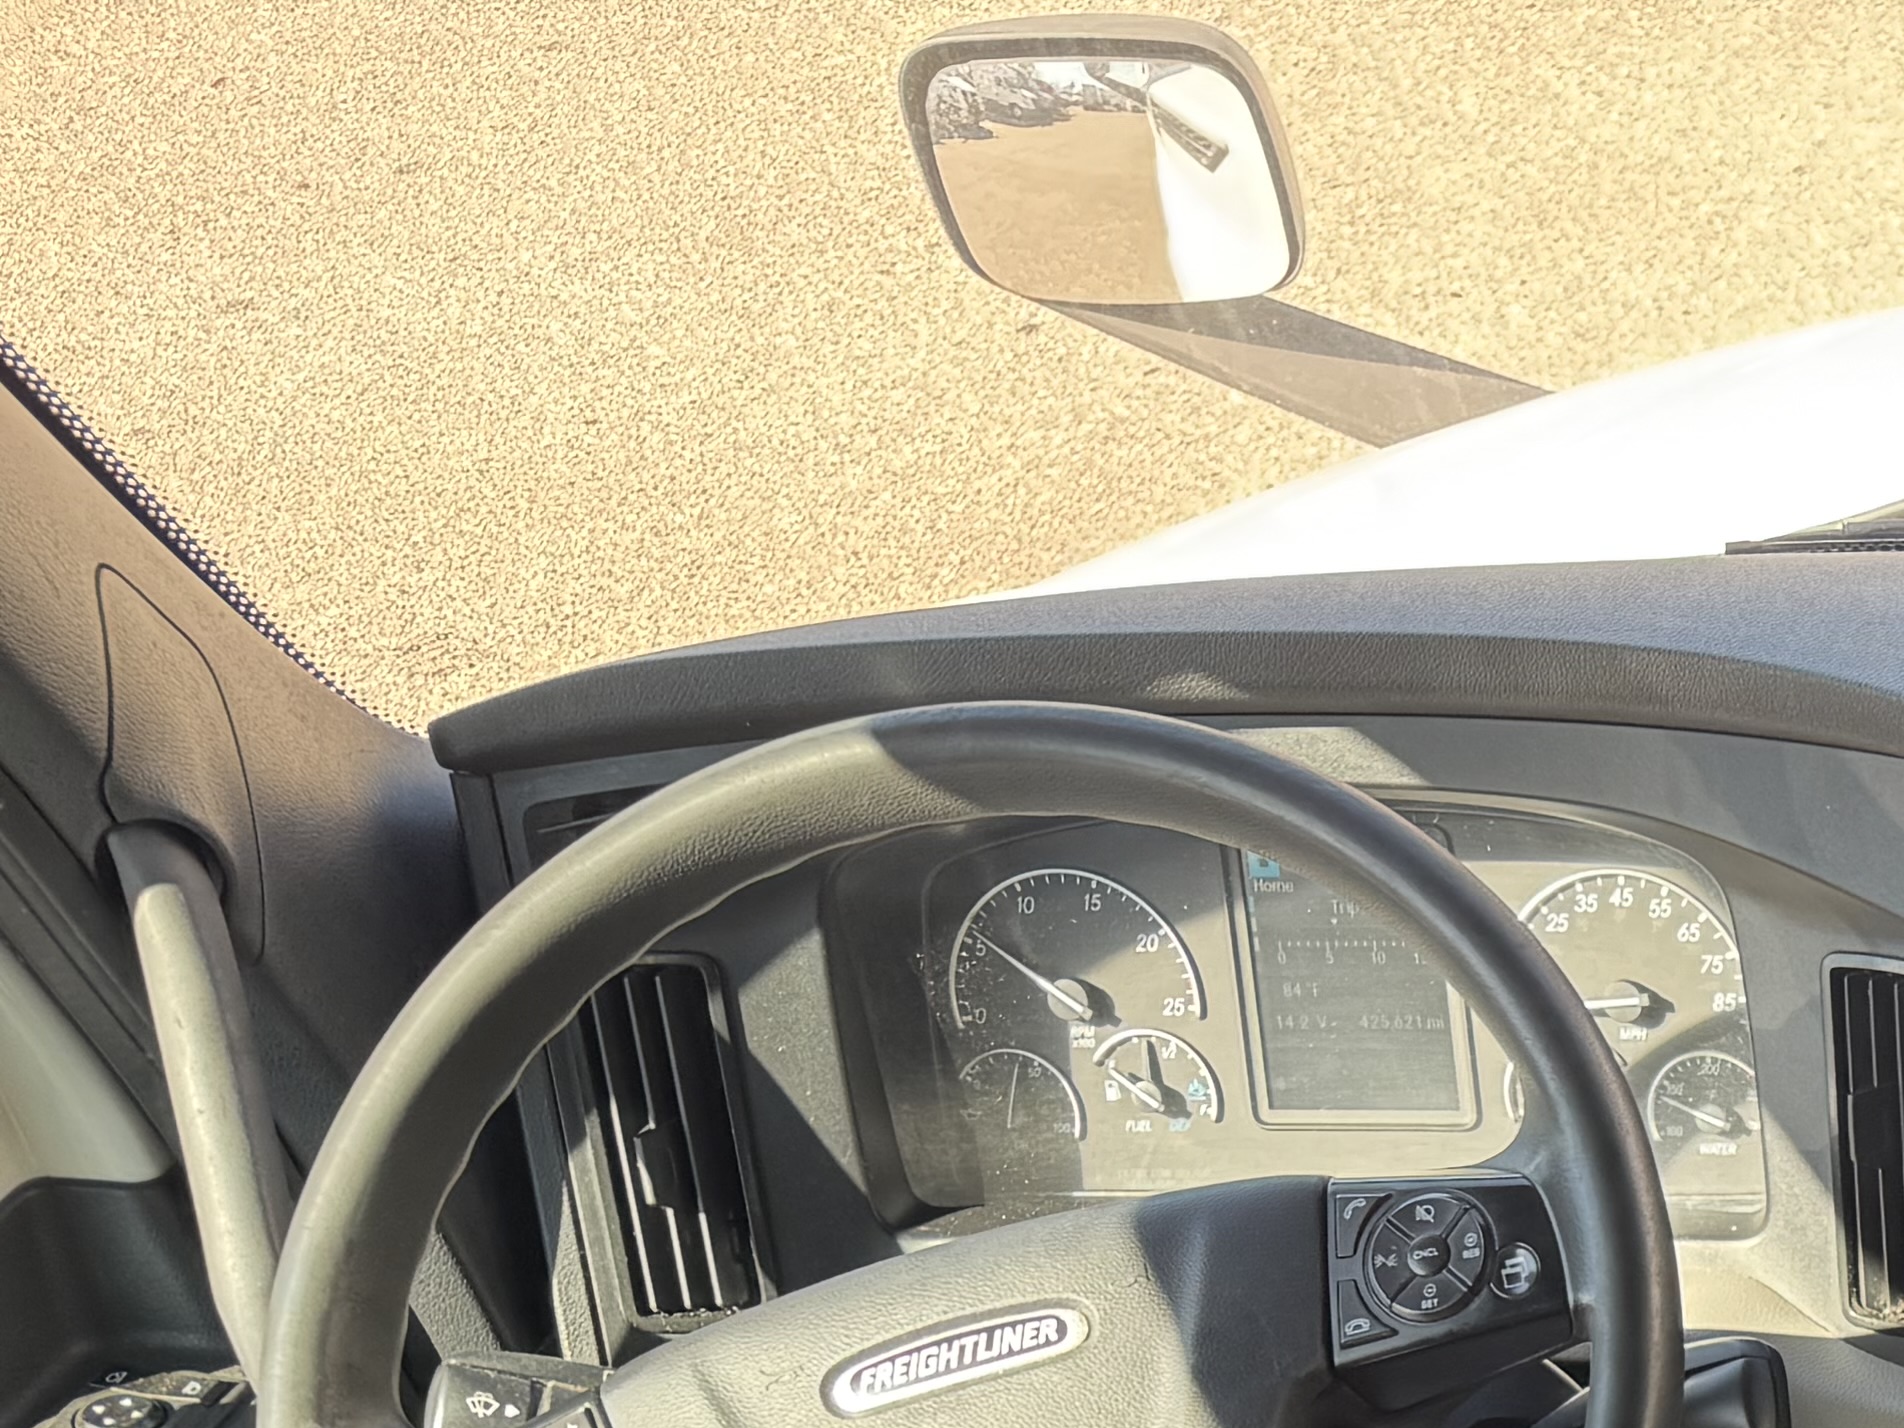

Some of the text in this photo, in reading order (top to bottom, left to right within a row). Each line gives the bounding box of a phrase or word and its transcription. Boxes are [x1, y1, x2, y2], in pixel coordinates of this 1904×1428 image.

[1253, 879, 1294, 893] Home
[1017, 897, 1034, 914] 10
[1084, 894, 1101, 911] 15
[1574, 894, 1598, 913] 35
[1609, 888, 1633, 907] 45
[1649, 899, 1671, 918] 55
[1545, 913, 1569, 932] 25
[1677, 923, 1700, 942] 65
[975, 940, 986, 956] 5
[1135, 934, 1159, 953] 20
[1372, 952, 1386, 965] 10
[1700, 955, 1723, 974] 75
[1162, 998, 1185, 1016] 25
[1713, 993, 1736, 1012] 85
[1619, 1028, 1648, 1041] MPH
[1125, 1120, 1152, 1133] FUEL
[1700, 1142, 1737, 1156] WATER
[1420, 1298, 1439, 1310] SET
[858, 1318, 1058, 1396] FREIGHTLINER
